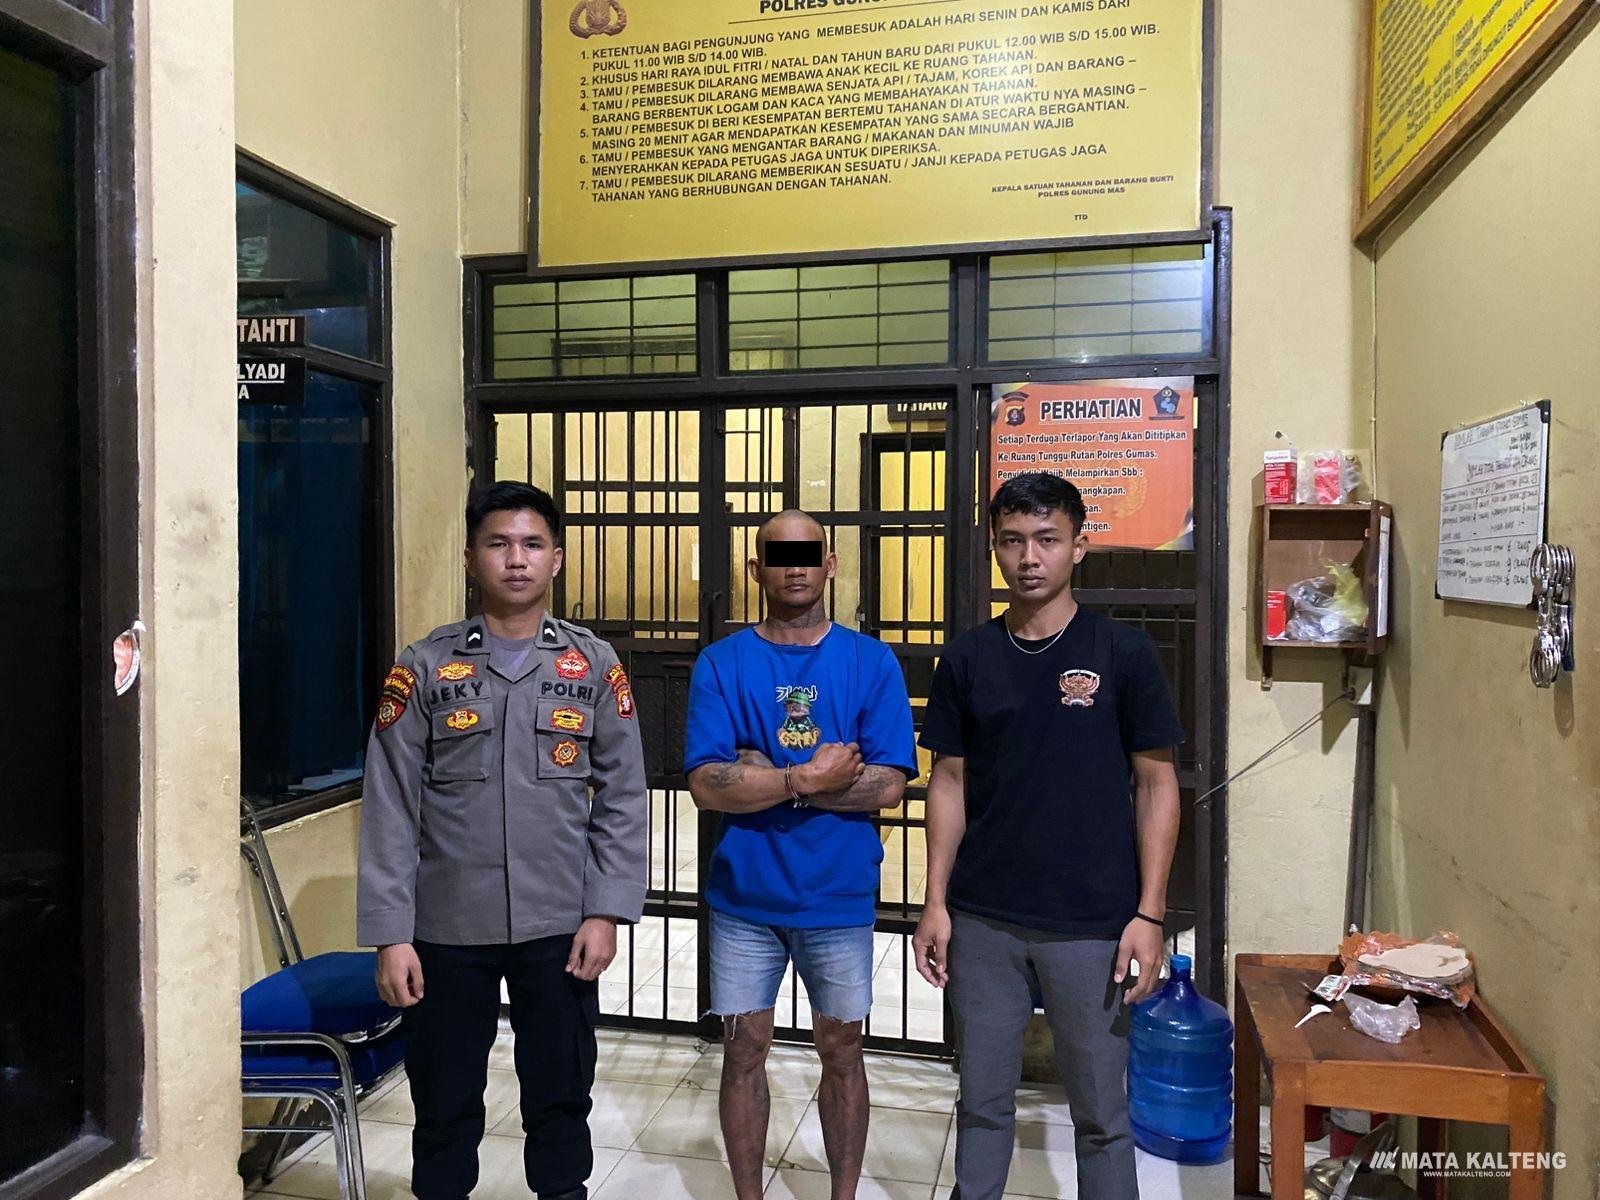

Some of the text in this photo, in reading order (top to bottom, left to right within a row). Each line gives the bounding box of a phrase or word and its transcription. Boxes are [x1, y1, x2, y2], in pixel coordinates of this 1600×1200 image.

[760, 0, 829, 13] POLRES
[580, 0, 1130, 60] 1. KETENTUAN BAGI PENGUNJUNG YANG MEMBESUK ADALAH HARI SENIN DAN KAMIS DARI
[580, 23, 1160, 86] 2. KHUSUS HARI RAYA IDUL FITRI NATAL DAN TAHUN BARU DARI PUKUL 12.00 WIB S/D 15.00 WIB.
[592, 46, 767, 72] PUKUL 11.00 WIB S/D 14.00 WIB.
[580, 49, 1037, 99] 3. TAMU PEMBESUK DILARANG MEMBAWA ANAK KECIL KE RUANG TAHANAN.
[591, 55, 1125, 111] TAMU PEMBESUK DILARANG MEMBAWA SENJATA API TAJAM, KOREK API DAN BARANG
[579, 83, 1135, 138] 5. TAMU PEMBESUK DI BERI KESEMPATAN BERTEMU TAHANAN DI ATUR WAKTU NYA MASING
[592, 78, 1038, 124] BARANG BERBENTUK LOGAM DAN KACA YANG MEMBAHAYAKAN TAHANAN.
[592, 98, 1129, 150] MASING 20 MENIT AGAR MENDAPATKAN KESEMPATAN YANG SAMA SECARA BERGANTIAN.
[591, 117, 1074, 163] TAMU PEMBESUK YANG MENGANTAR BARANG MAKANAN DAN MINUMAN WAJIB
[579, 143, 1107, 190] 7. TAMU PEMBESUK DILARANG MEMBERIKAN SESUATU JANJI KEPADA PETUGAS JAGA
[591, 142, 940, 176] MENYERAHKAN KEPADA PETUGAS JAGA UNTUK DIPERIKSA.
[592, 173, 891, 202] TAHANAN YANG BERHUBUNGAN DENGAN TAHANAN.
[992, 175, 1174, 193] KEPALA SATUAN TAHANAN DAN BARANG BUKTI
[1038, 186, 1126, 198] POLRES GUNUNG MAS
[237, 319, 296, 343] TAHTI
[237, 363, 285, 380] LYADI
[1041, 398, 1141, 420] PERHATIAN
[998, 430, 1186, 445] Setiap Terduga Terlapor Yang Akan Dititipkan
[998, 449, 1158, 463] Ke Ruang Tunggu Rutan Polres Gumas.
[1065, 467, 1138, 479] Melampirkan Sbb
[430, 681, 483, 704] JEKY
[541, 681, 593, 701] POLRI
